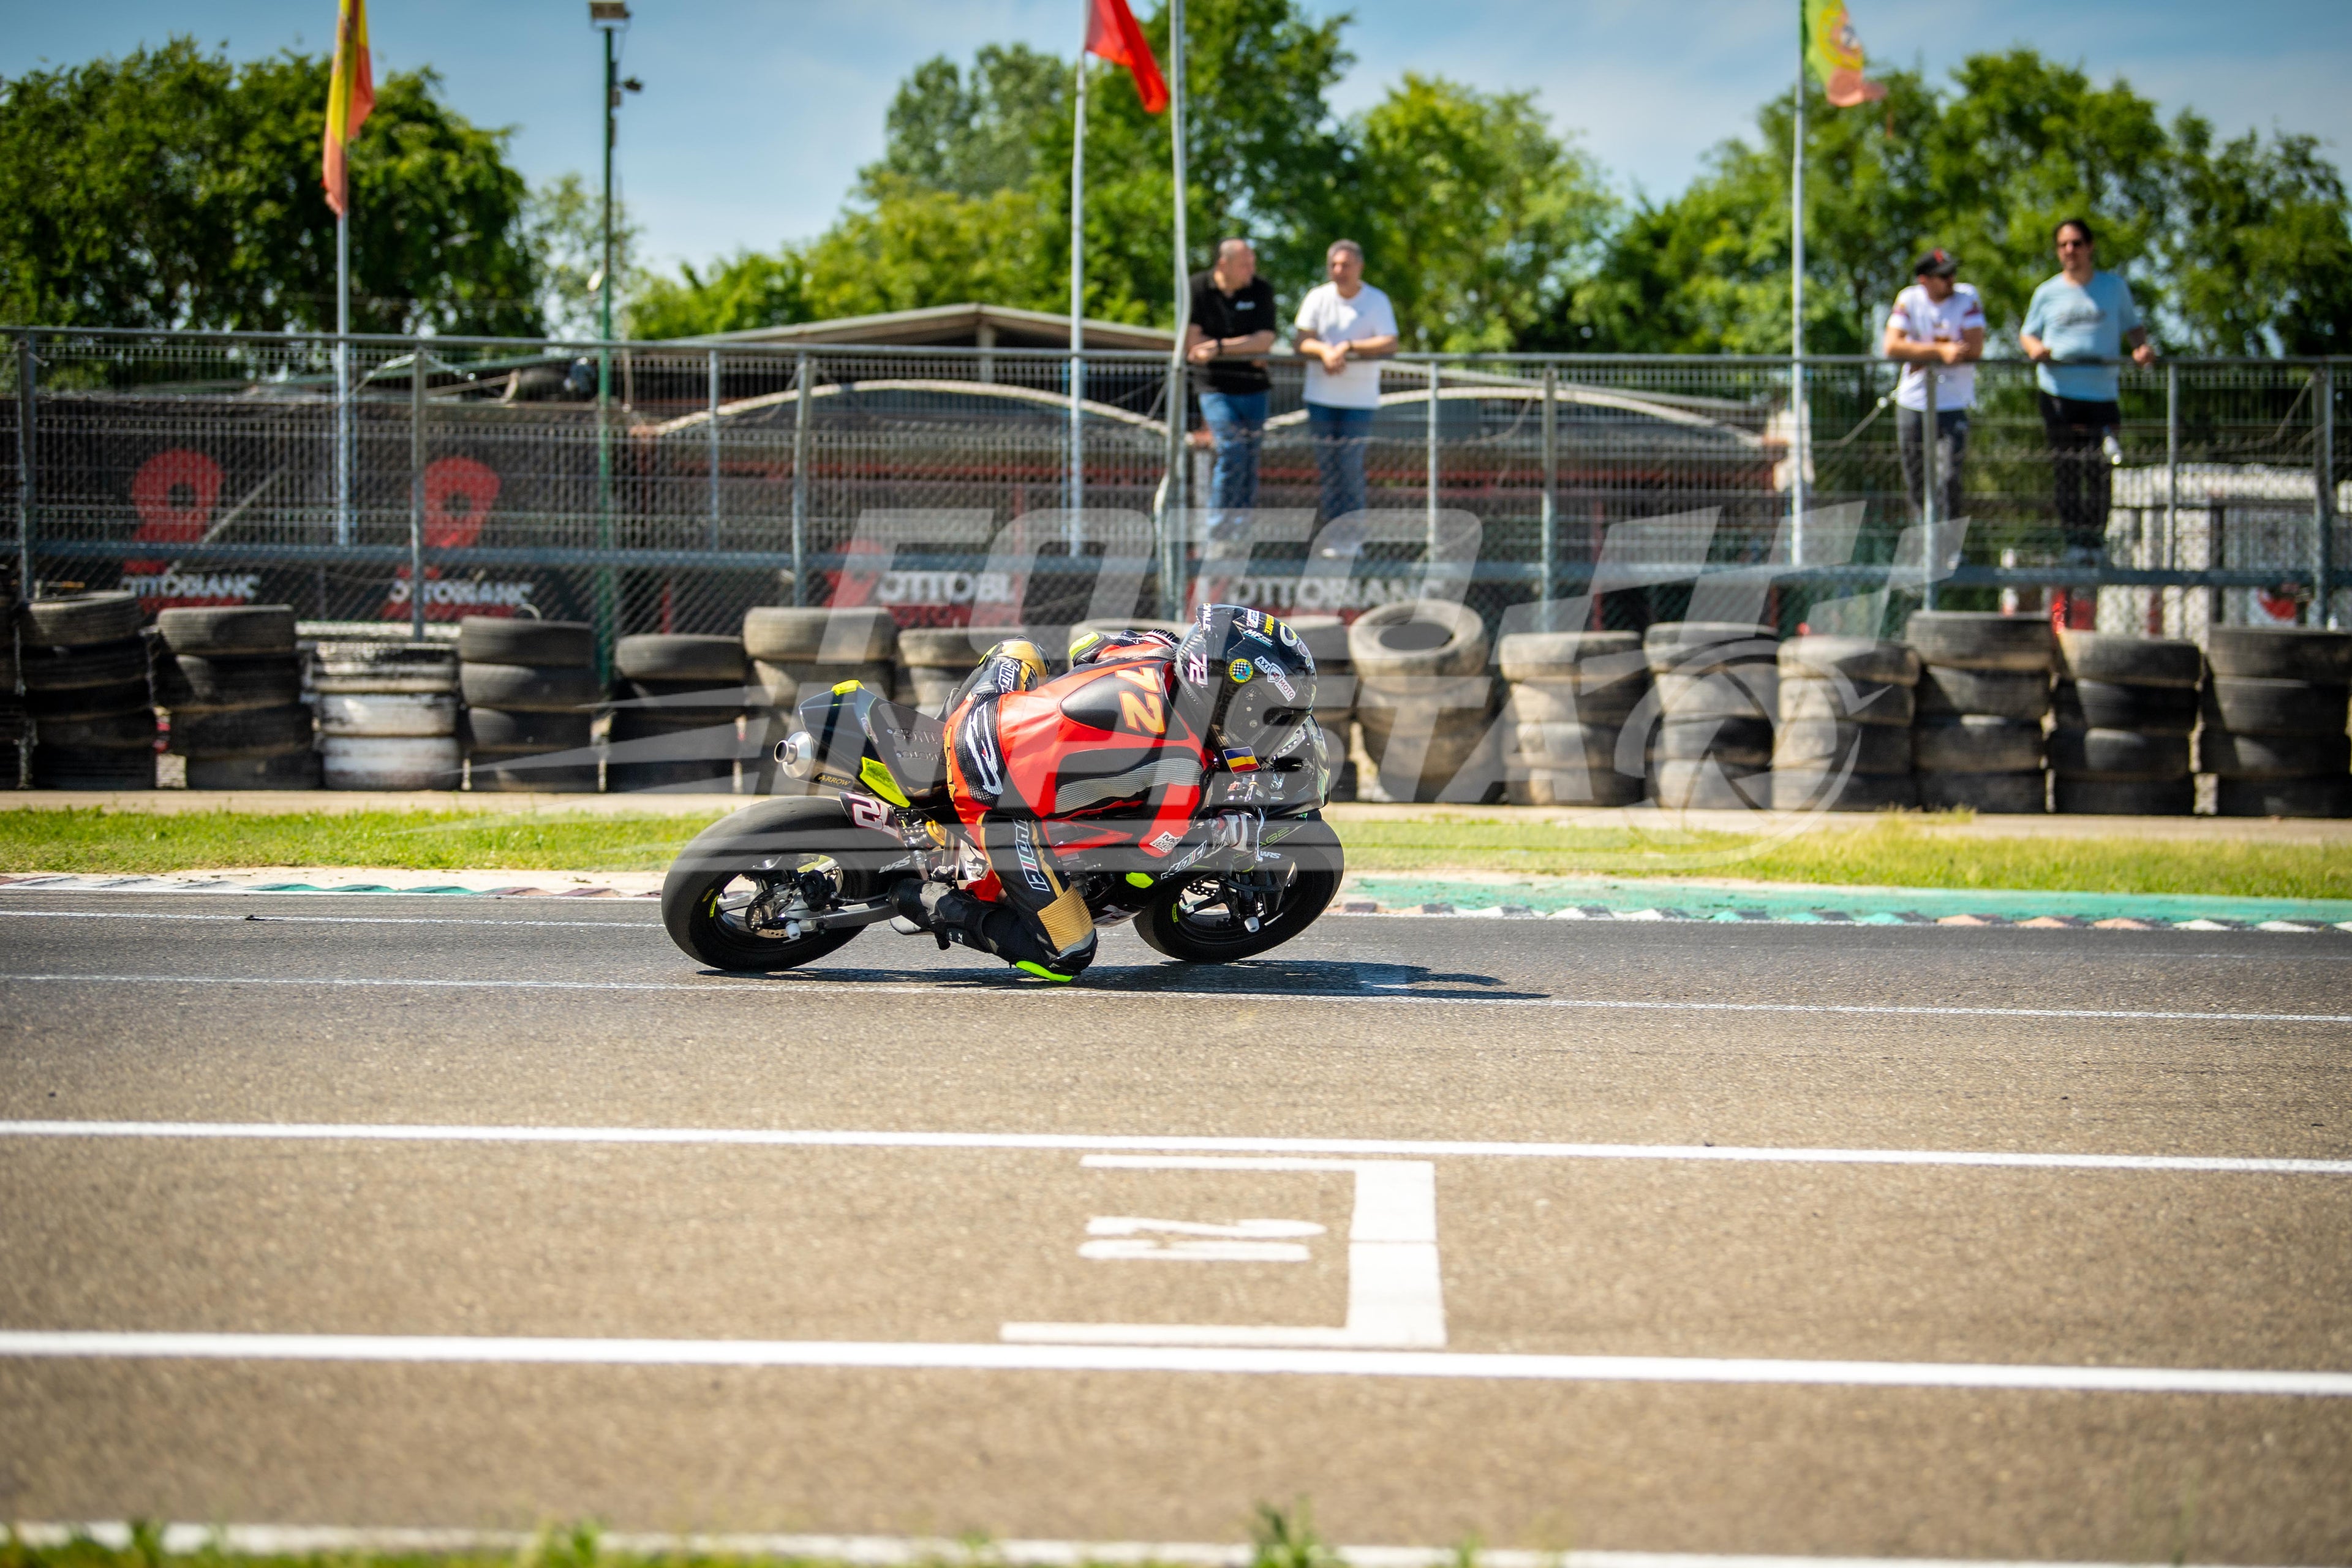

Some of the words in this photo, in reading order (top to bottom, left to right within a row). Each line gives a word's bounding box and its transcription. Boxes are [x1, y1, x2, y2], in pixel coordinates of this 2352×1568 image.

[1189, 651, 1208, 687] 72
[1256, 657, 1271, 671] AXI
[1278, 679, 1295, 699] MOTO
[1115, 666, 1166, 735] 72
[818, 775, 851, 786] ARROW
[878, 856, 911, 873] WRS
